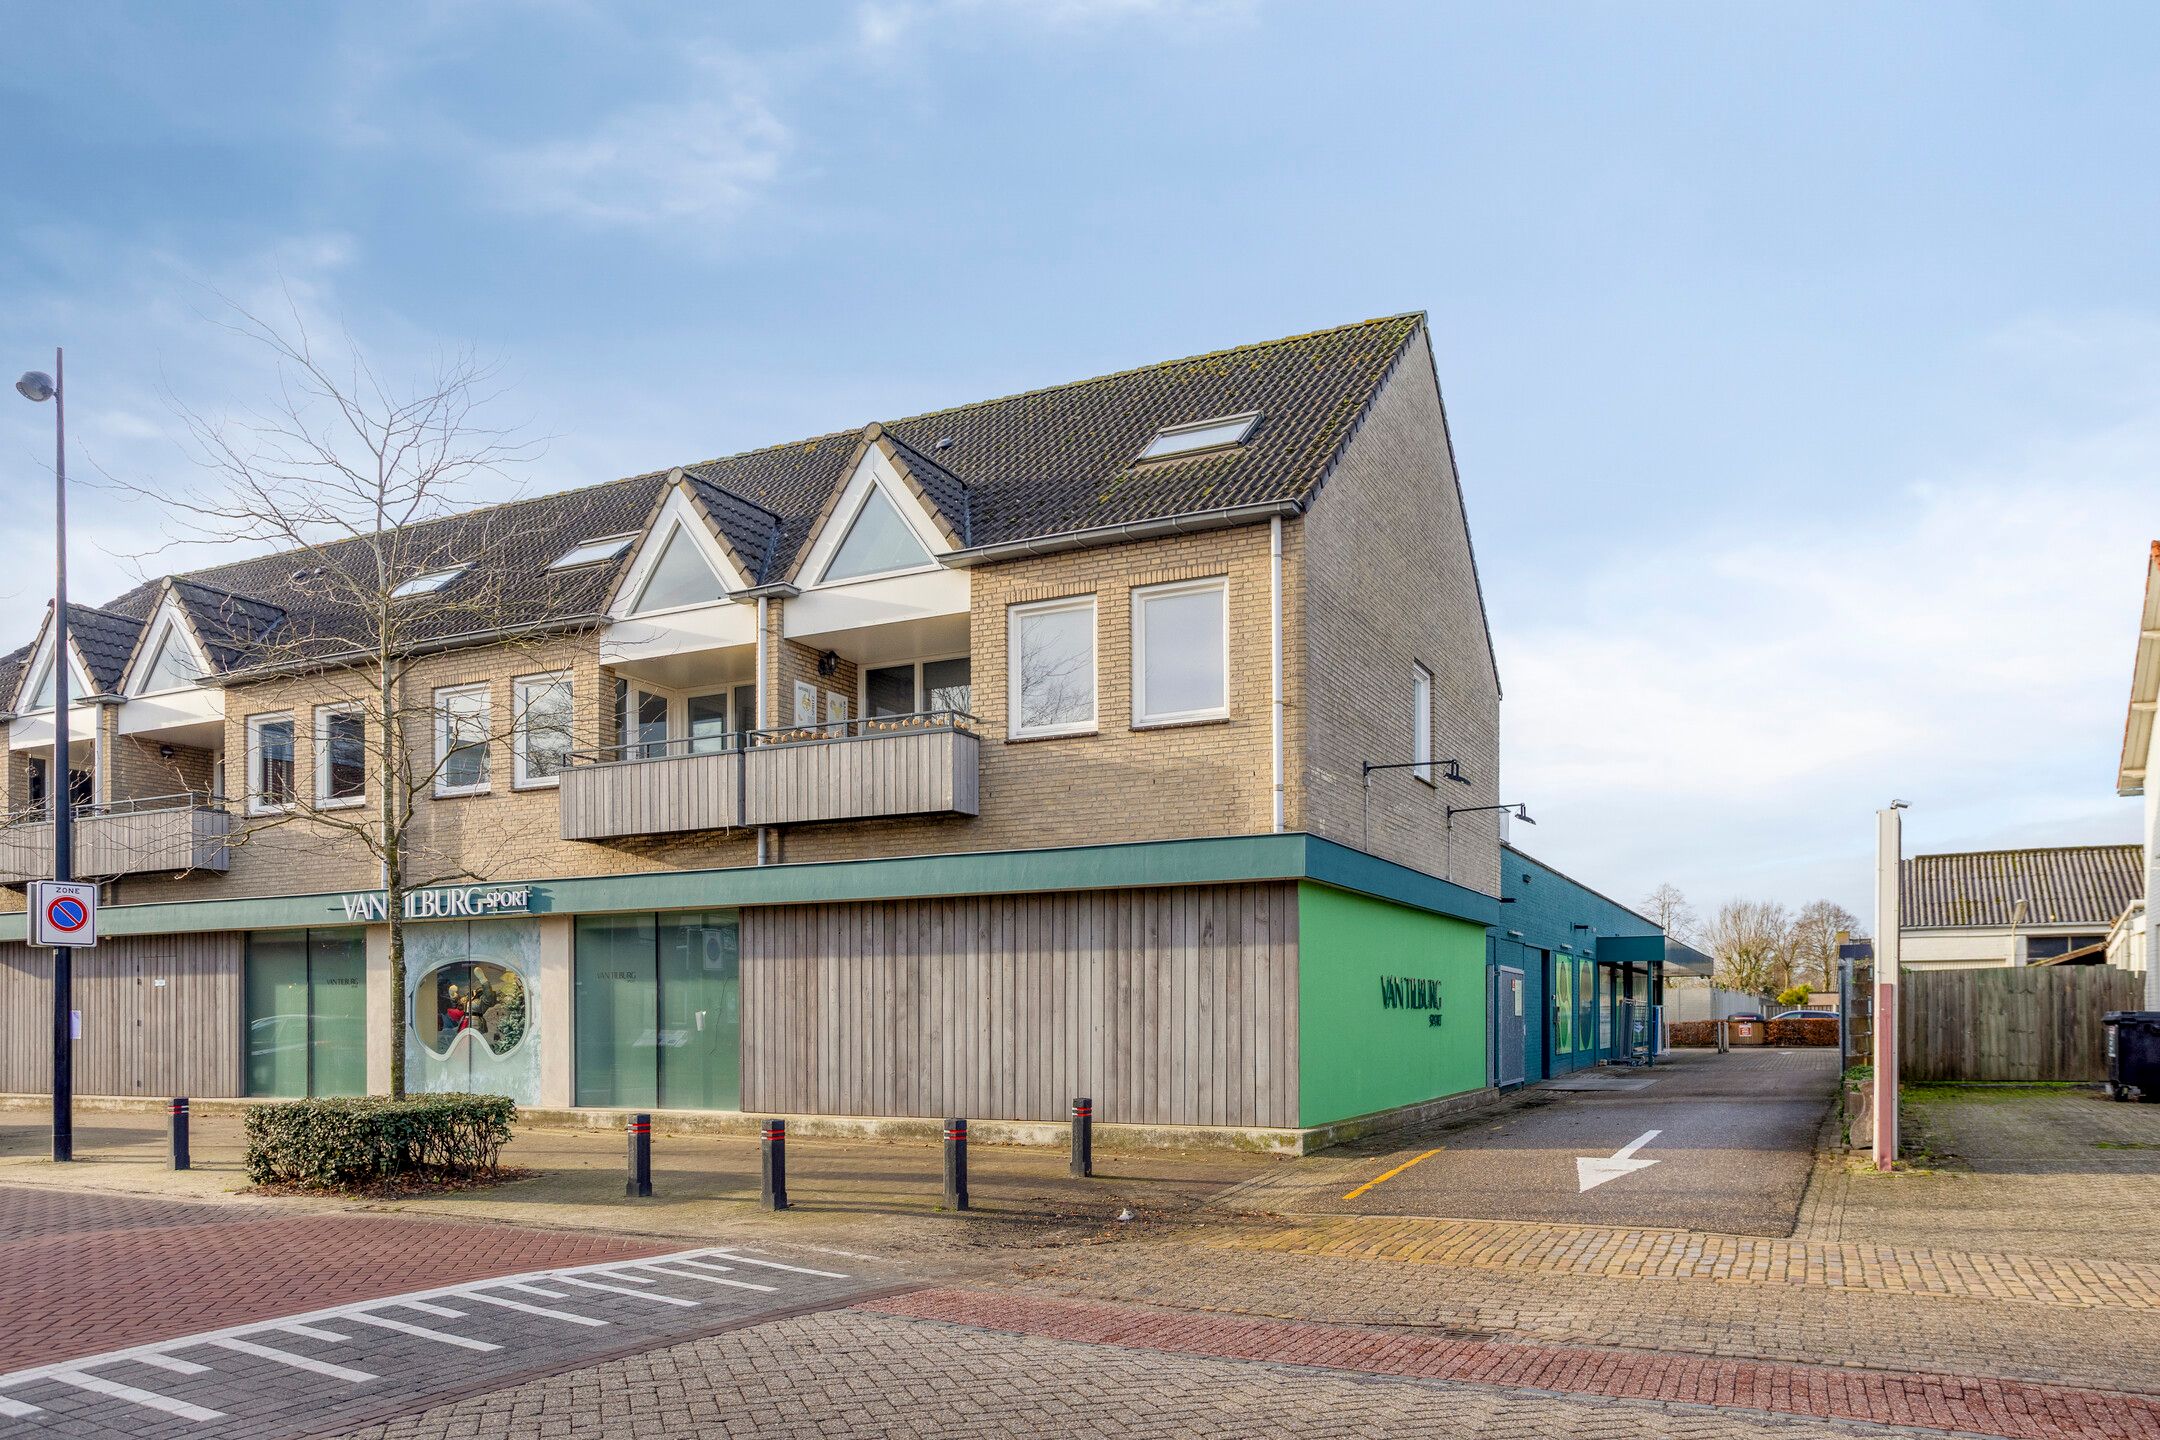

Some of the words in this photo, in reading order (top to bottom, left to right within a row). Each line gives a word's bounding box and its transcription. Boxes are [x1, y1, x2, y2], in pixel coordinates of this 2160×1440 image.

[342, 893, 387, 920] VAN
[401, 887, 486, 918] ILBURG
[487, 890, 530, 908] SPORT
